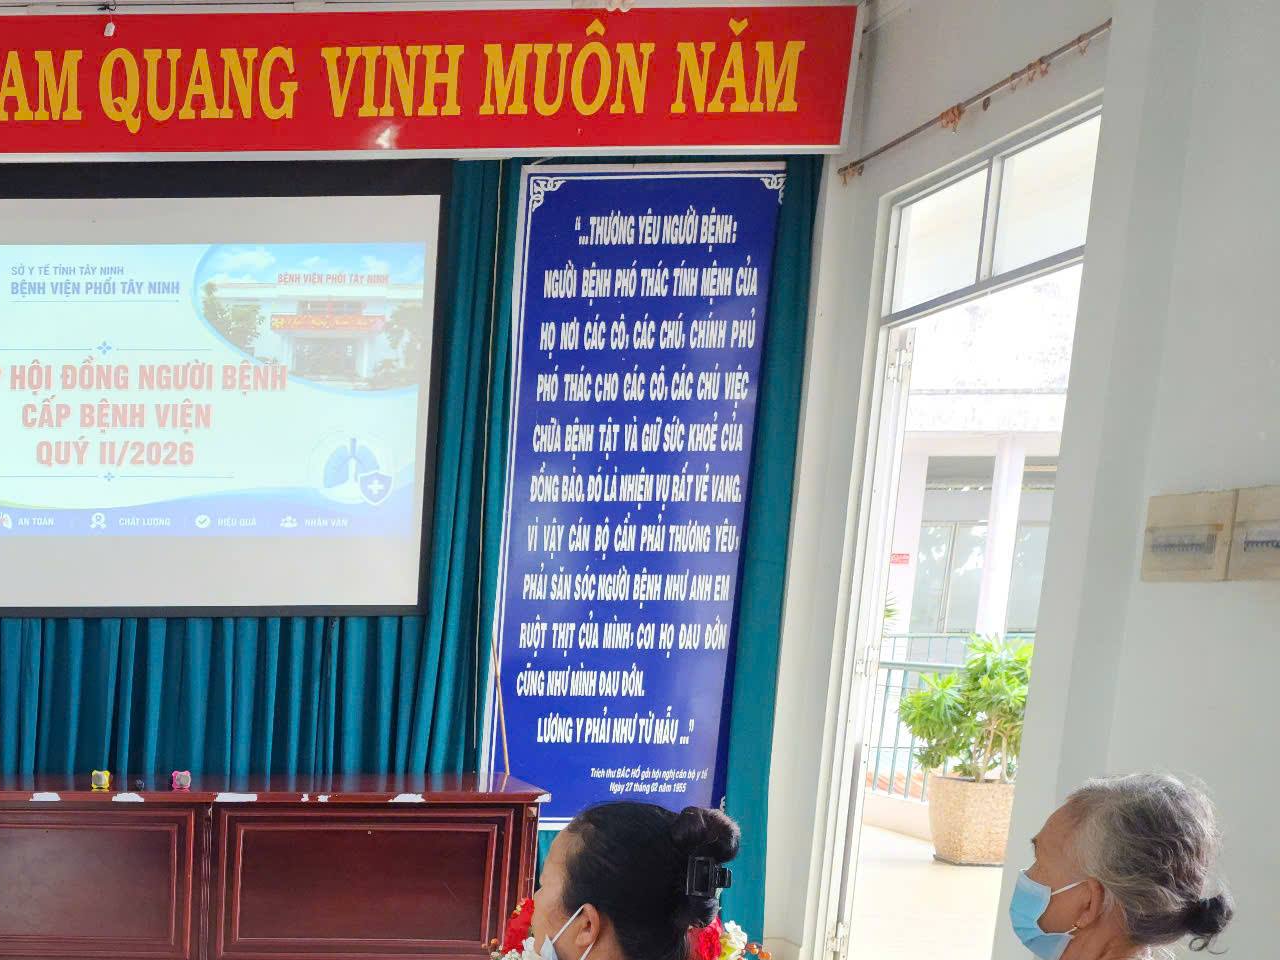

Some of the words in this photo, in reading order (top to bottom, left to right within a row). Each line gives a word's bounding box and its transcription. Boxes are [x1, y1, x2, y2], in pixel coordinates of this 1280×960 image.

[99, 46, 298, 133] QUANG
[321, 45, 464, 117] VINH
[479, 19, 655, 116] MUÔN
[671, 19, 805, 113] NĂM
[639, 208, 661, 244] YÊU
[662, 205, 699, 244] NGƯỜI
[700, 207, 737, 252] BỆNH:
[11, 265, 24, 275] SỞ
[28, 266, 35, 275] Y
[39, 264, 50, 275] TẾ
[53, 264, 75, 275] TỈNH
[79, 264, 96, 275] TÂY
[100, 267, 124, 275] NINH
[11, 279, 45, 298] BỆNH
[50, 279, 80, 298] VIỆN
[121, 279, 143, 295] TÂY
[148, 282, 179, 294] NINH
[544, 260, 577, 298] NGƯỜI
[581, 262, 611, 306] BỆNH
[614, 260, 637, 297] PHÓ
[641, 260, 669, 297] THÁC
[673, 260, 698, 296] TÍNH
[701, 260, 733, 305] MỆNH
[736, 255, 757, 296] CỦA
[540, 322, 555, 359] HỌ
[560, 317, 579, 350] NƠI
[584, 314, 606, 350] CÁC
[611, 314, 629, 350] CÔ,
[633, 313, 655, 349] CÁC
[660, 313, 685, 349] CHÚ,
[690, 312, 727, 349] CHÍNH
[731, 308, 755, 348] PHỦ
[10, 359, 51, 395] HỘI
[61, 355, 129, 391] ĐỒNG
[138, 360, 213, 391] NGƯỜI
[222, 359, 288, 395] BỆNH
[21, 395, 70, 428] CẤP
[80, 399, 145, 433] BỆNH
[155, 399, 211, 433] VIỆN
[533, 417, 561, 452] CHỮA
[564, 417, 594, 460] BỆNH
[599, 417, 620, 460] TẬT
[625, 416, 637, 451] VÀ
[642, 417, 662, 452] GIỮ
[663, 416, 685, 452] SỨC
[721, 411, 743, 451] CỦA
[36, 436, 89, 468] QUÝ
[100, 441, 194, 467] II/2026
[530, 462, 559, 502] ĐỒNG
[587, 466, 602, 502] ĐÓ
[604, 466, 617, 501] LÀ
[619, 467, 654, 510] NHIỆM
[656, 475, 670, 510] VỤ
[671, 462, 694, 502] RẤT
[695, 463, 709, 502] VẺ
[712, 475, 741, 502] VANG.
[528, 517, 538, 551] VÌ
[544, 518, 564, 559] VẬY
[568, 517, 590, 552] CÁN
[594, 517, 609, 560] BỘ
[614, 512, 636, 552] CẦN
[640, 514, 665, 551] PHẢI
[669, 520, 711, 552] THƯƠNG
[716, 518, 739, 552] YÊU,
[523, 562, 547, 599] PHẢI
[550, 566, 571, 600] SĂN
[574, 565, 596, 600] SÓC
[597, 565, 630, 601] NGƯỜI
[633, 567, 662, 609] BỆNH
[664, 569, 689, 601] NHƯ
[689, 575, 712, 601] ANH
[714, 575, 730, 601] EM
[517, 663, 544, 696] CŨNG
[547, 666, 570, 696] NHƯ
[570, 662, 597, 696] MÌNH
[599, 671, 620, 697] ĐAU
[537, 712, 573, 743] LƯƠNG
[576, 718, 584, 742] Y
[585, 706, 611, 743] PHẢI
[612, 713, 638, 744] NHƯ
[639, 711, 654, 744] TỪ
[653, 706, 679, 744] MẪU
[625, 782, 633, 792] 27
